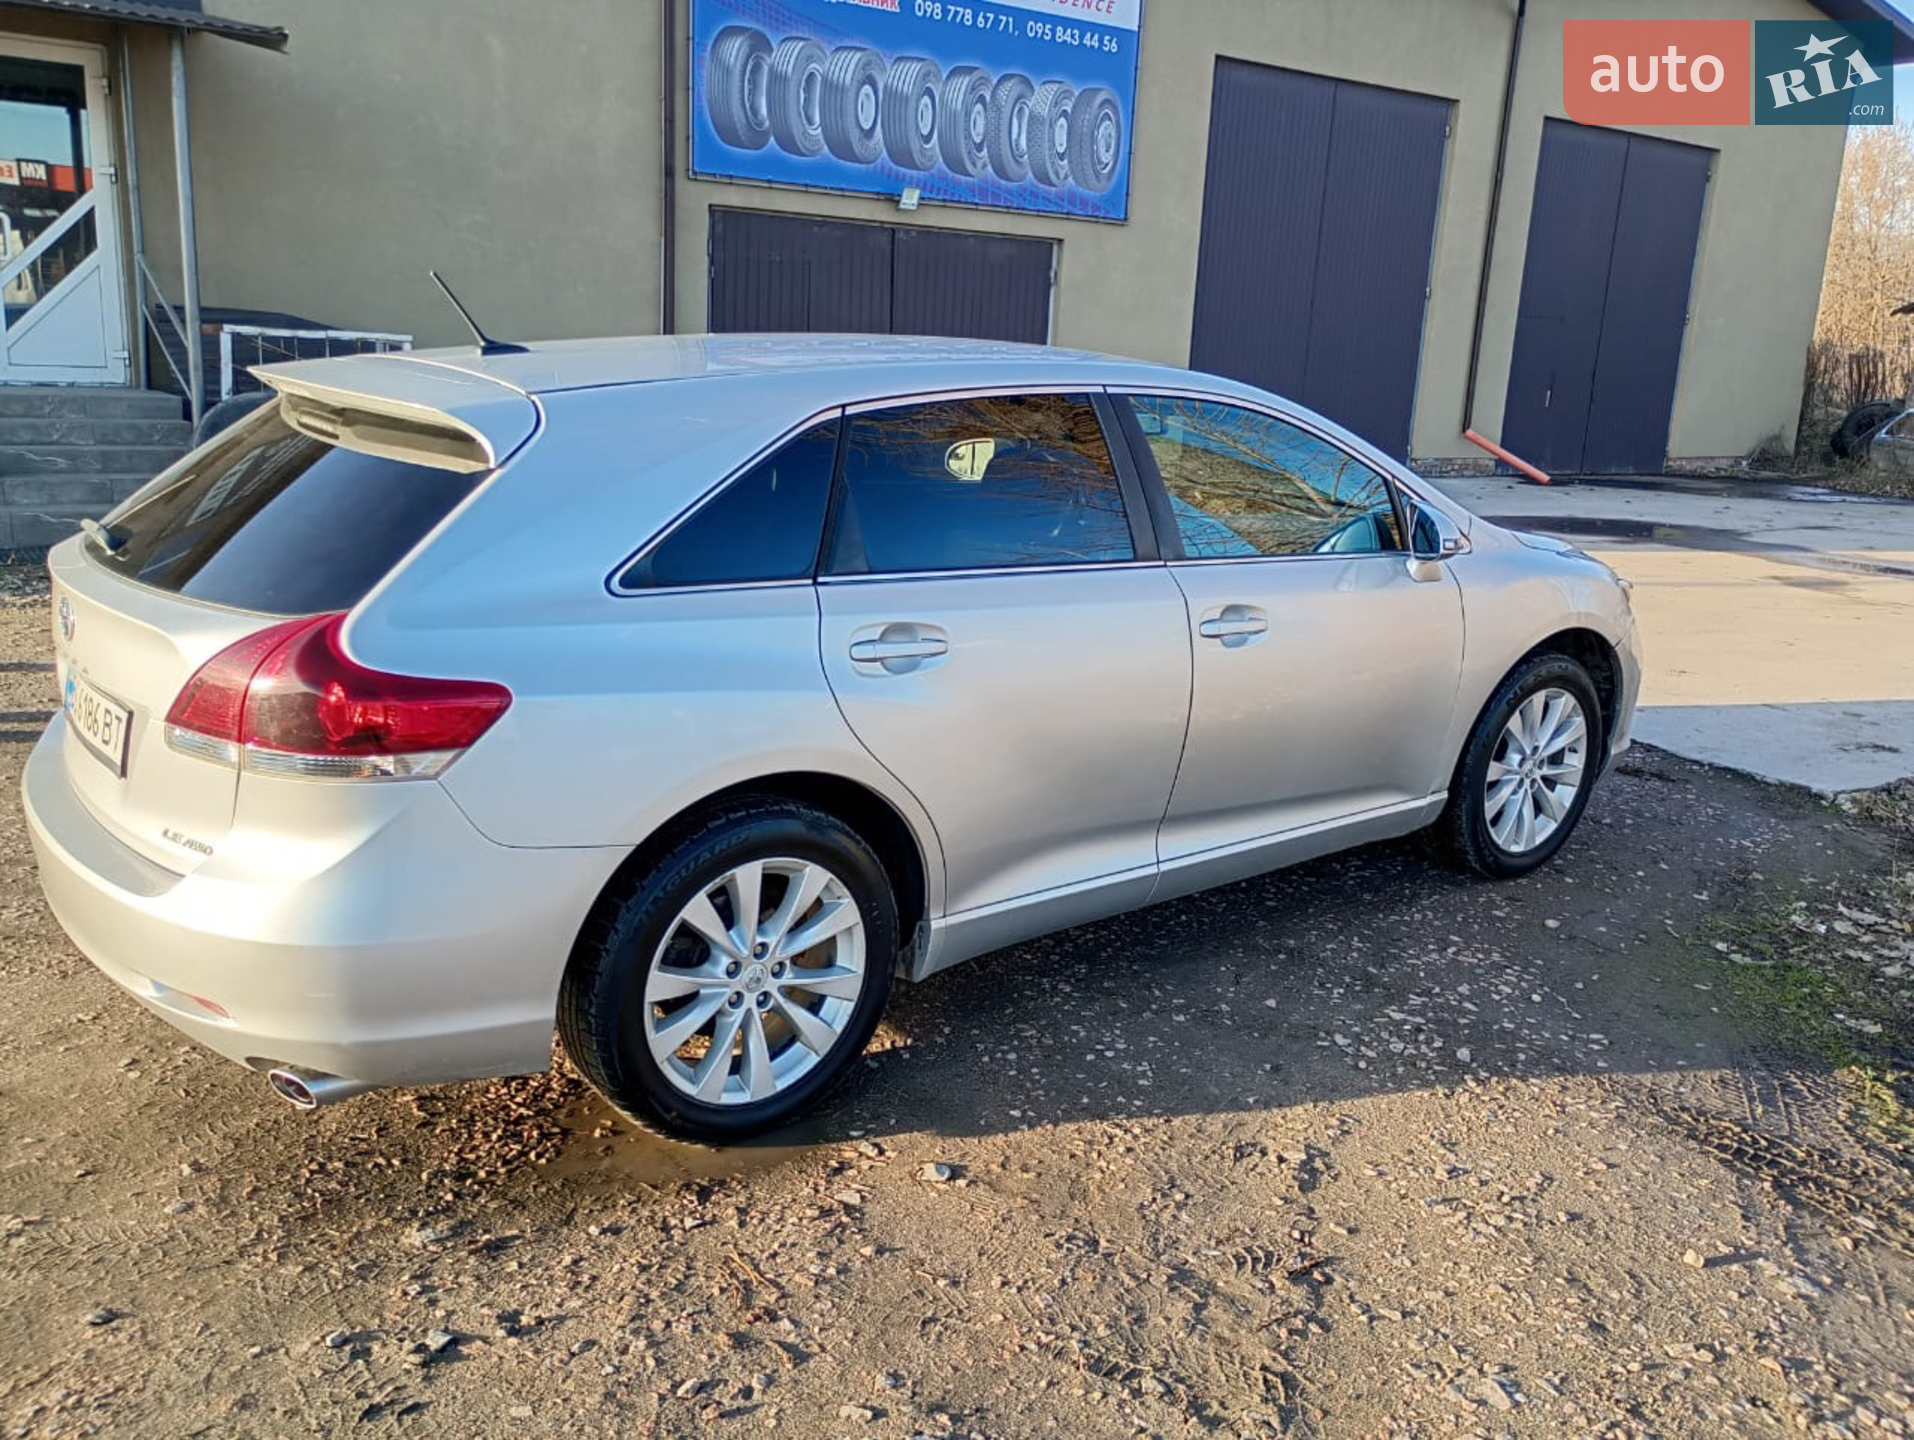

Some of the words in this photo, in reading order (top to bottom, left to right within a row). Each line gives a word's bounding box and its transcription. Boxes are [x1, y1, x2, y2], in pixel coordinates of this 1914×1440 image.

[914, 1, 943, 20] 098
[946, 5, 973, 26] 778
[977, 12, 995, 29] 67
[998, 16, 1020, 36] 71,
[1026, 21, 1052, 40] 095
[1055, 26, 1080, 46] 843
[1083, 32, 1100, 49] 44
[1102, 36, 1119, 52] 56
[102, 707, 123, 754] BT
